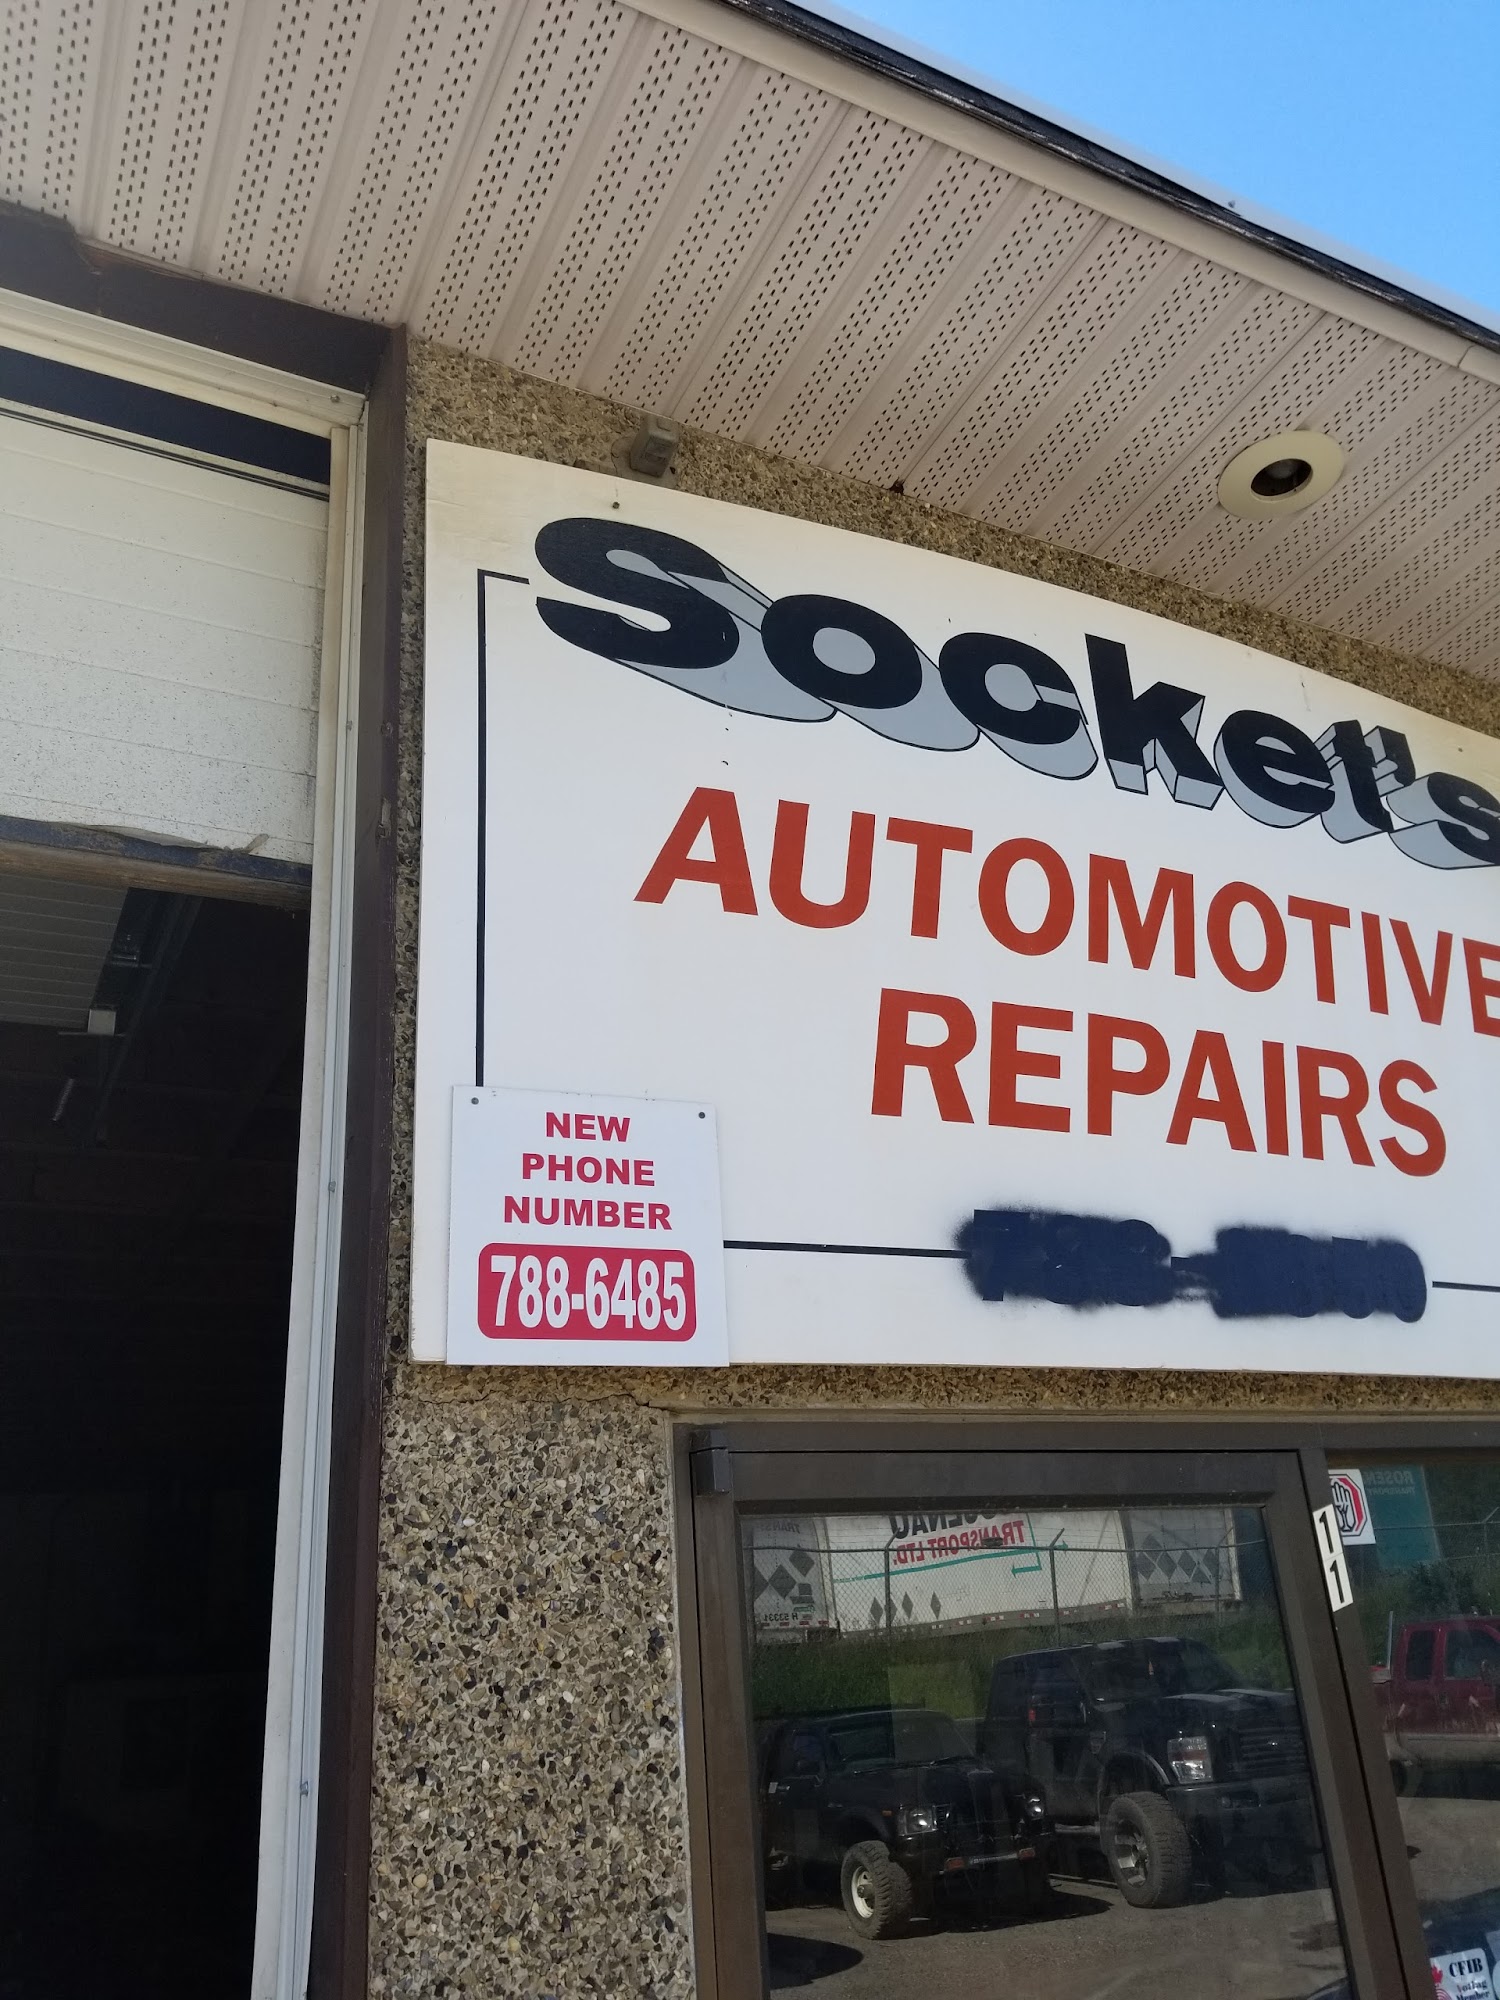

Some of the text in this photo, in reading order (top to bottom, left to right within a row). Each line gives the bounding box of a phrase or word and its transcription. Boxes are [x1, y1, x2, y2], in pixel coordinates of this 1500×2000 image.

[535, 517, 1500, 869] Socket's
[634, 786, 1500, 1038] AUTOMOTIVE
[871, 988, 1447, 1177] REPAIRS
[545, 1112, 631, 1142] NEW
[522, 1153, 655, 1187] PHONE
[504, 1195, 672, 1230] NUMBER
[491, 1255, 686, 1331] 788-6485
[1449, 1957, 1483, 1977] CFIB
